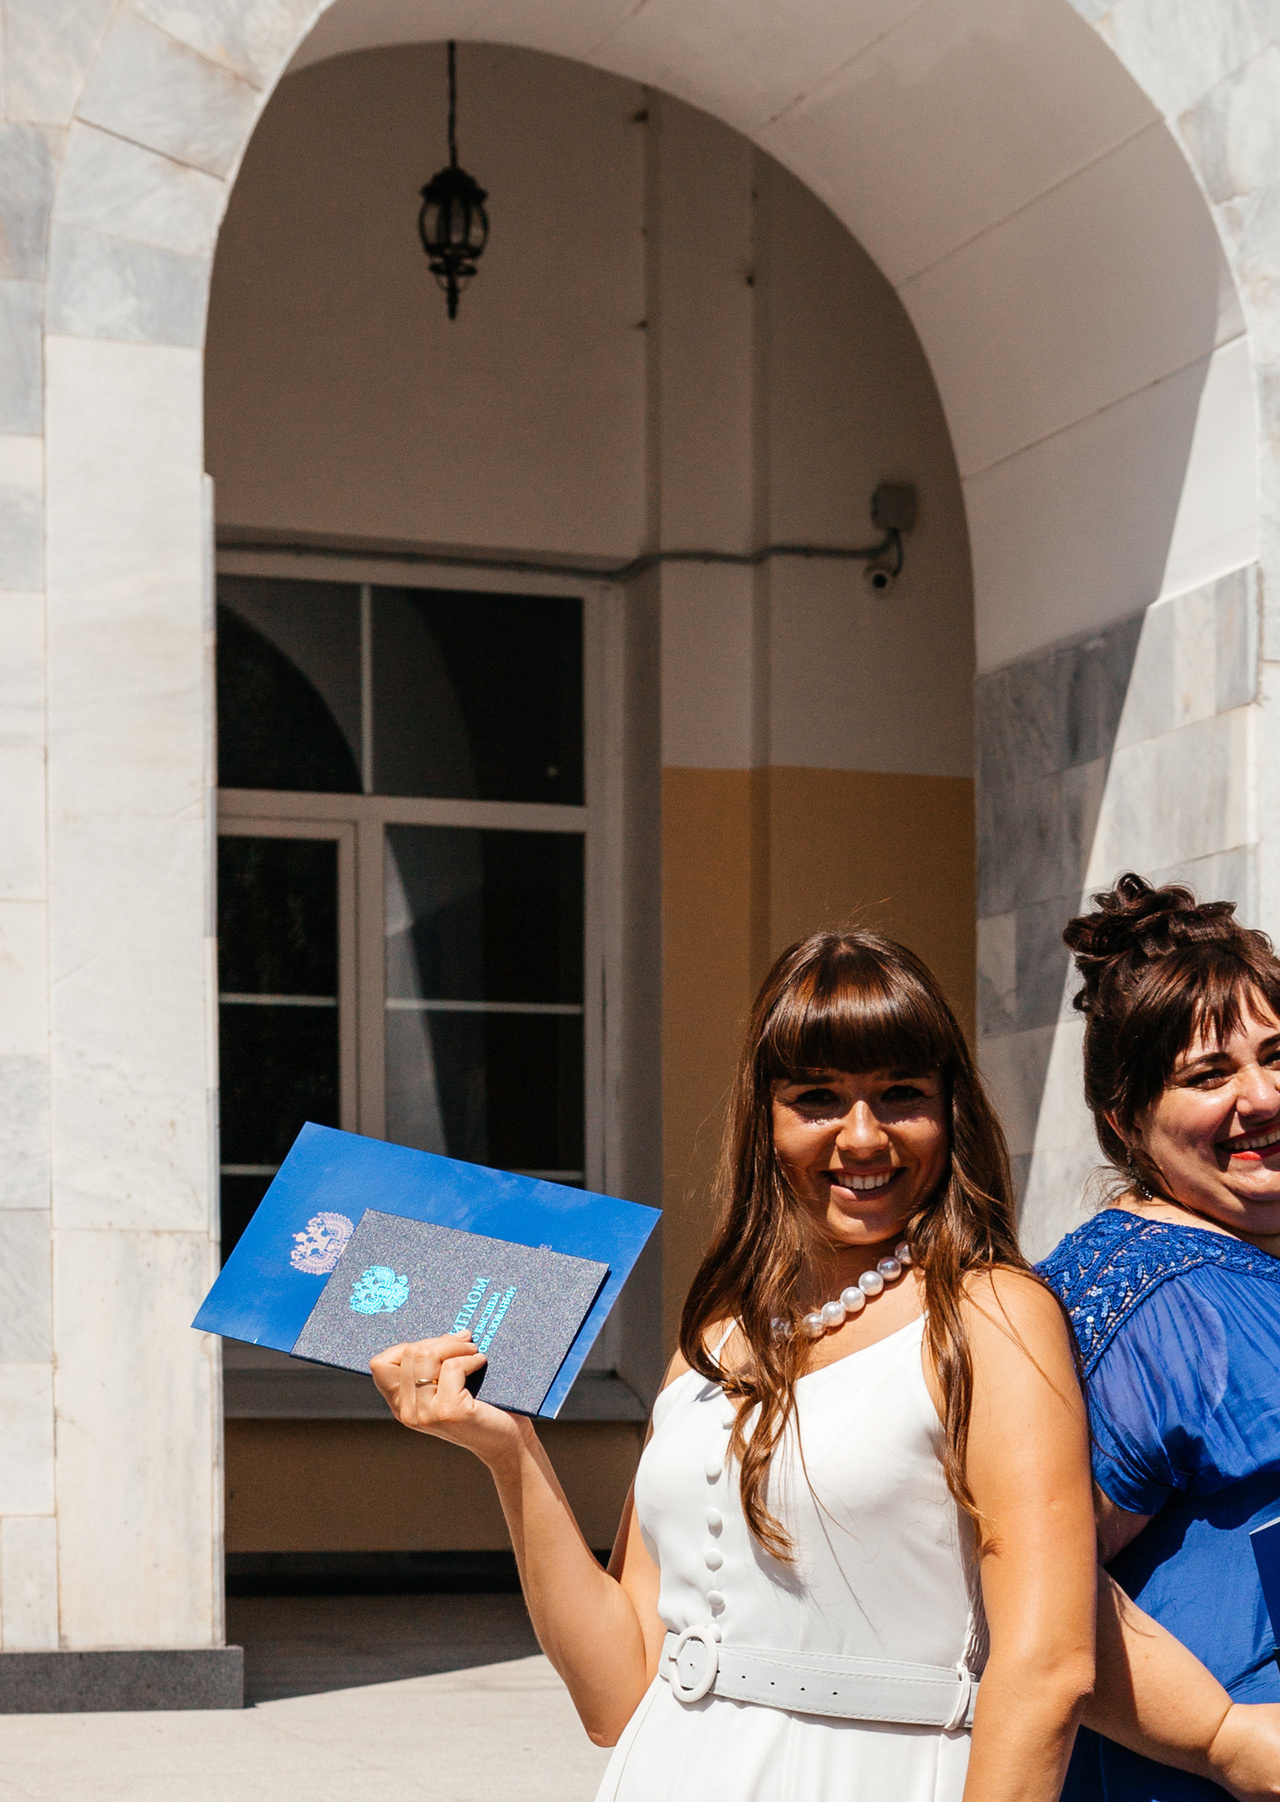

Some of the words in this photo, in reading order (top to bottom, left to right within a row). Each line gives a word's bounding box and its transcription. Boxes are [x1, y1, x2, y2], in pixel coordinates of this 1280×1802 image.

[447, 1277, 491, 1335] ИПЛОМ
[473, 1291, 502, 1334] ВЫСШЕМ
[478, 1285, 518, 1353] ОБРАЗОВАНИИ
